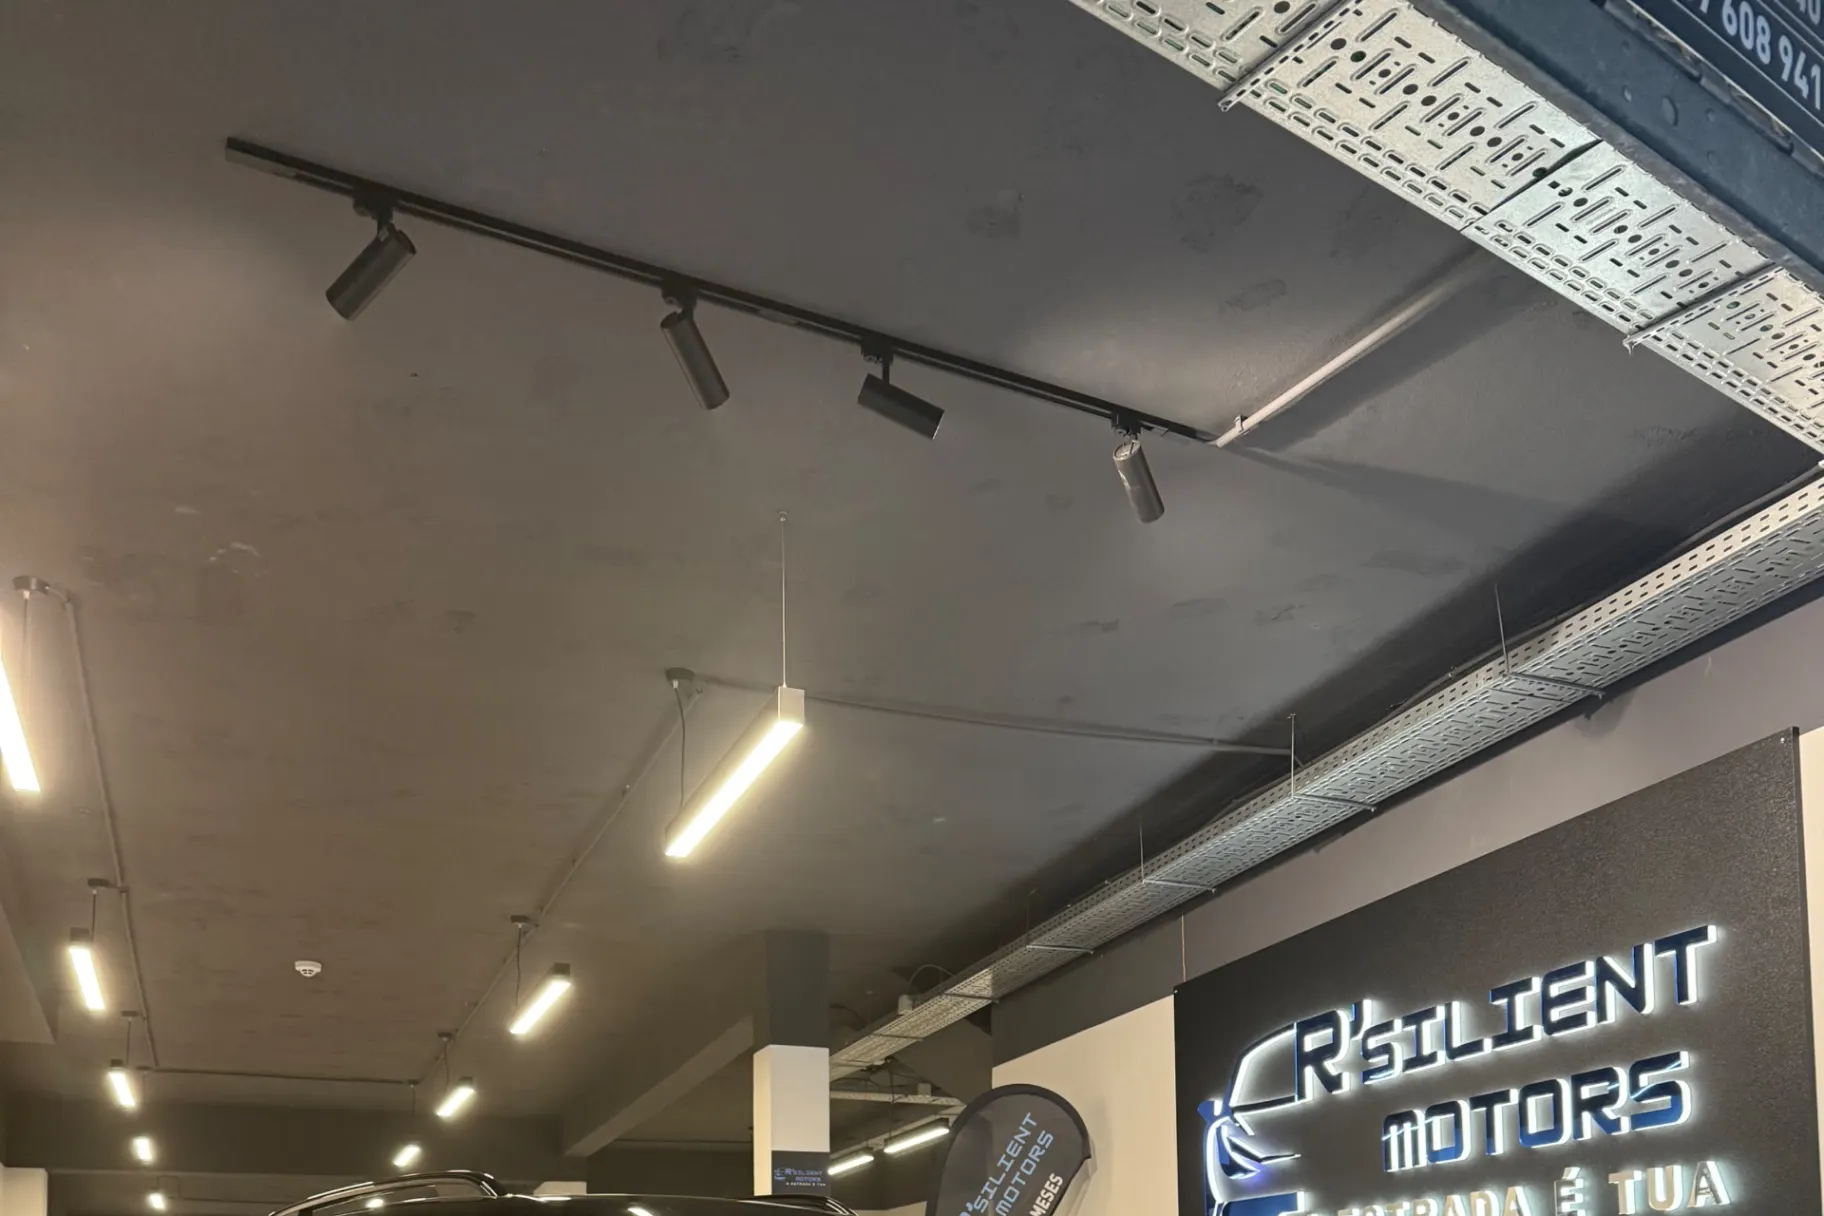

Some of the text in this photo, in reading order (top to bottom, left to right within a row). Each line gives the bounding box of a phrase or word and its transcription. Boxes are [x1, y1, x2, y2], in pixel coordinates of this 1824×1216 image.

[1722, 0, 1821, 111] 608 941
[1295, 925, 1717, 1101] R'SILIENT
[1382, 1051, 1692, 1173] MOTORS
[995, 1130, 1054, 1216] MOTORS
[1608, 1160, 1731, 1216] TUA
